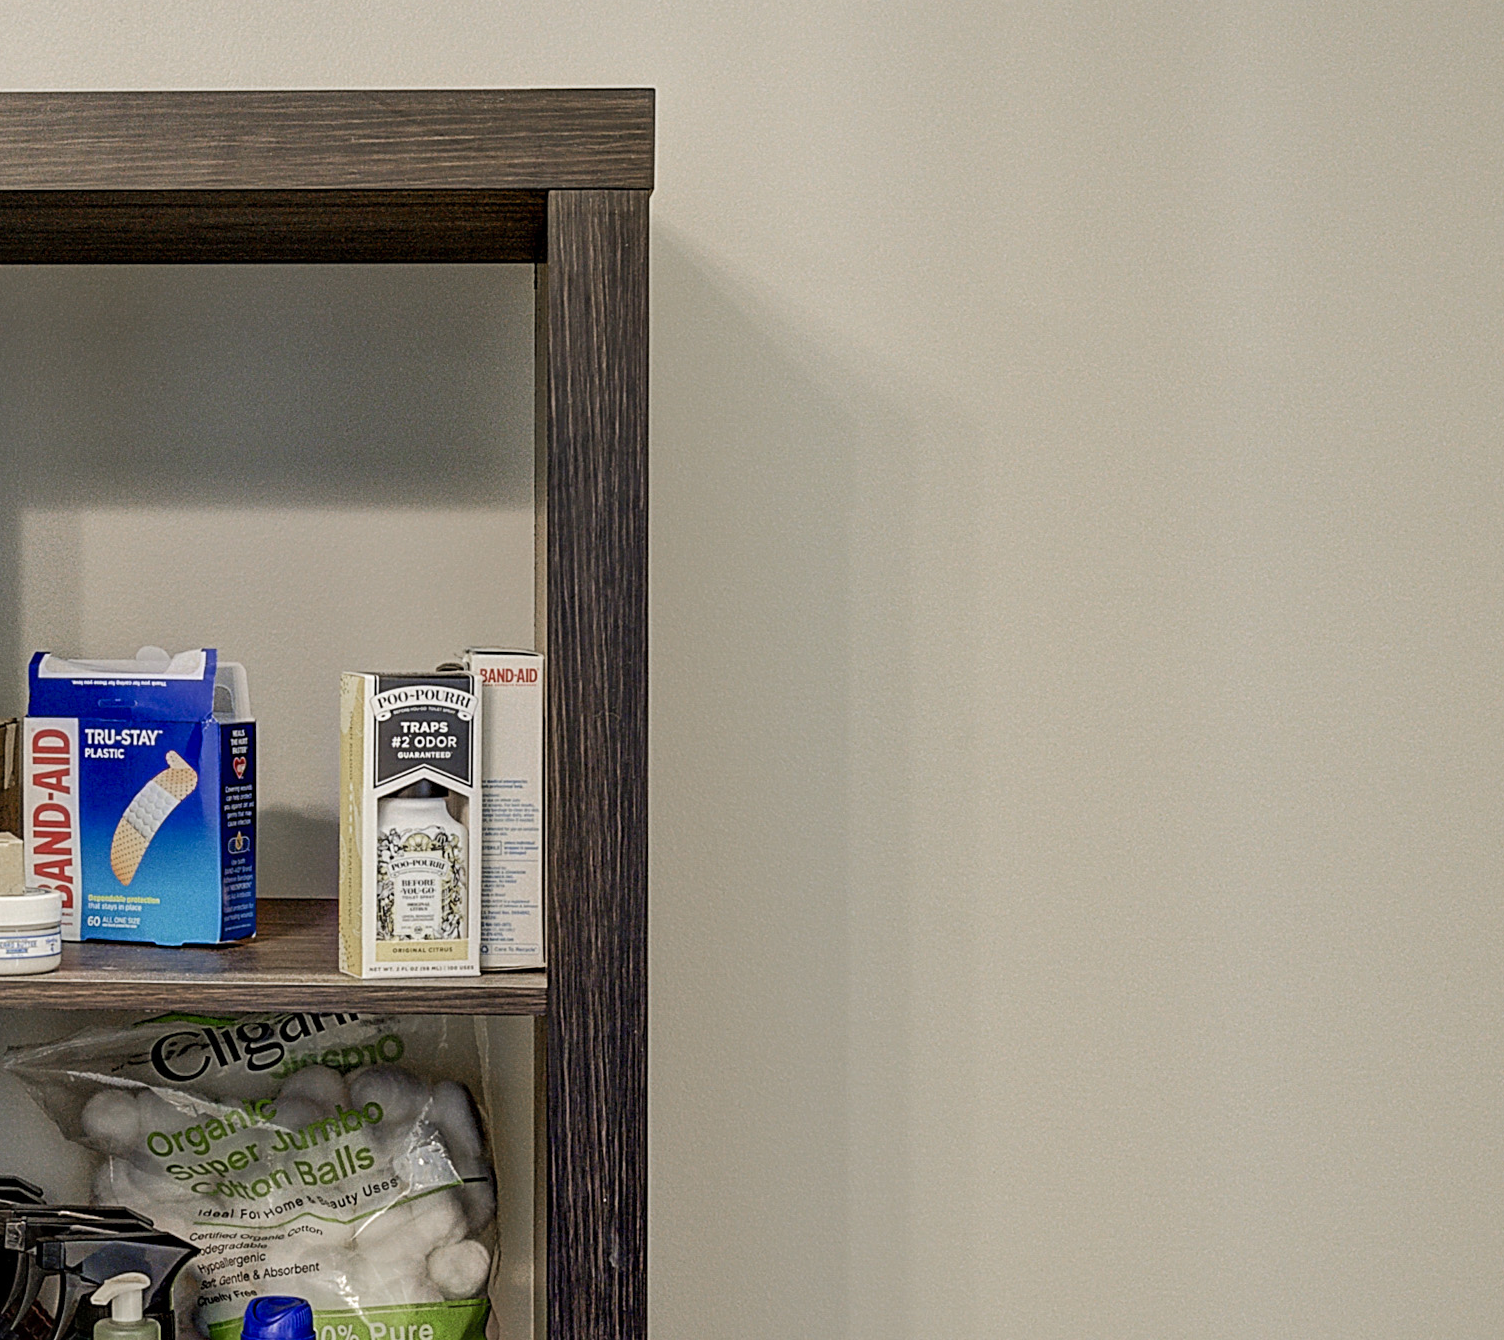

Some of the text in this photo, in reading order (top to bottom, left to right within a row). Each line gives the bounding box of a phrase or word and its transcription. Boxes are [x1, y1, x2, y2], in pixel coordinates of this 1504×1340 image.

[480, 668, 538, 683] BAND-AID
[400, 722, 448, 733] TRAPS
[414, 736, 457, 748] ODOR
[84, 748, 125, 759] PLASTIC
[32, 728, 74, 909] BAND-AID
[126, 904, 142, 912] place
[87, 916, 100, 926] 60
[147, 1098, 277, 1158] Organic
[166, 1102, 384, 1181] Super Jumbo
[190, 1144, 375, 1200] Cotton Balls
[198, 1209, 234, 1218] Ideal
[265, 1198, 304, 1219] Home
[362, 1176, 398, 1198] Uses
[190, 1224, 324, 1242] Certified Organic Cotton
[197, 1242, 268, 1257] odegradable
[198, 1252, 266, 1276] Hypoallergenic
[219, 1271, 250, 1286] Gentle
[252, 1270, 260, 1280] &
[263, 1262, 320, 1279] Absorbent
